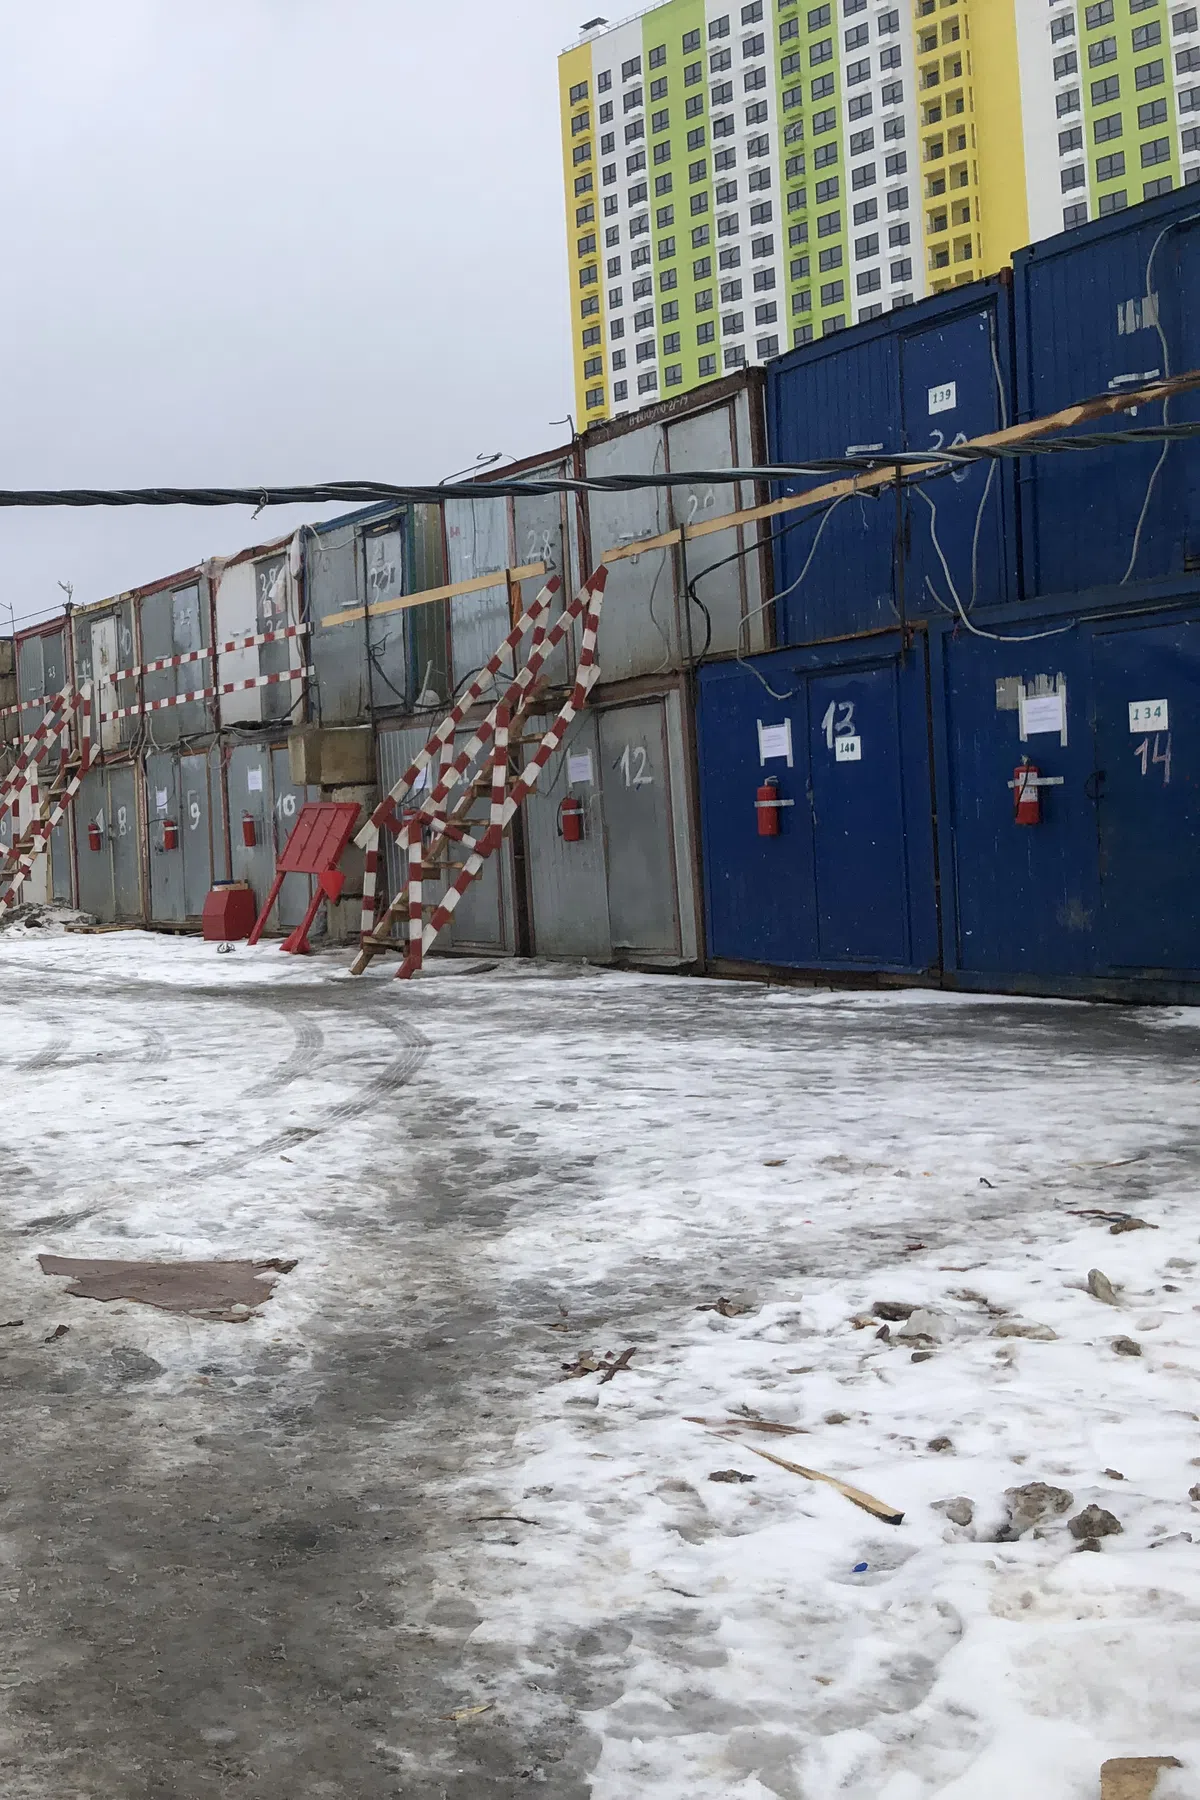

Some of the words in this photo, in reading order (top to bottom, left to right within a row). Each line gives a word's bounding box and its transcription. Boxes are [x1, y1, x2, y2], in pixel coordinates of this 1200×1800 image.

[933, 388, 952, 404] 139
[526, 529, 552, 560] 28
[821, 700, 856, 749] 13
[1133, 705, 1162, 721] 134
[840, 742, 855, 753] 140
[1133, 737, 1172, 784] 14
[620, 744, 653, 788] 12
[190, 802, 201, 831] 9
[276, 791, 296, 821] 10
